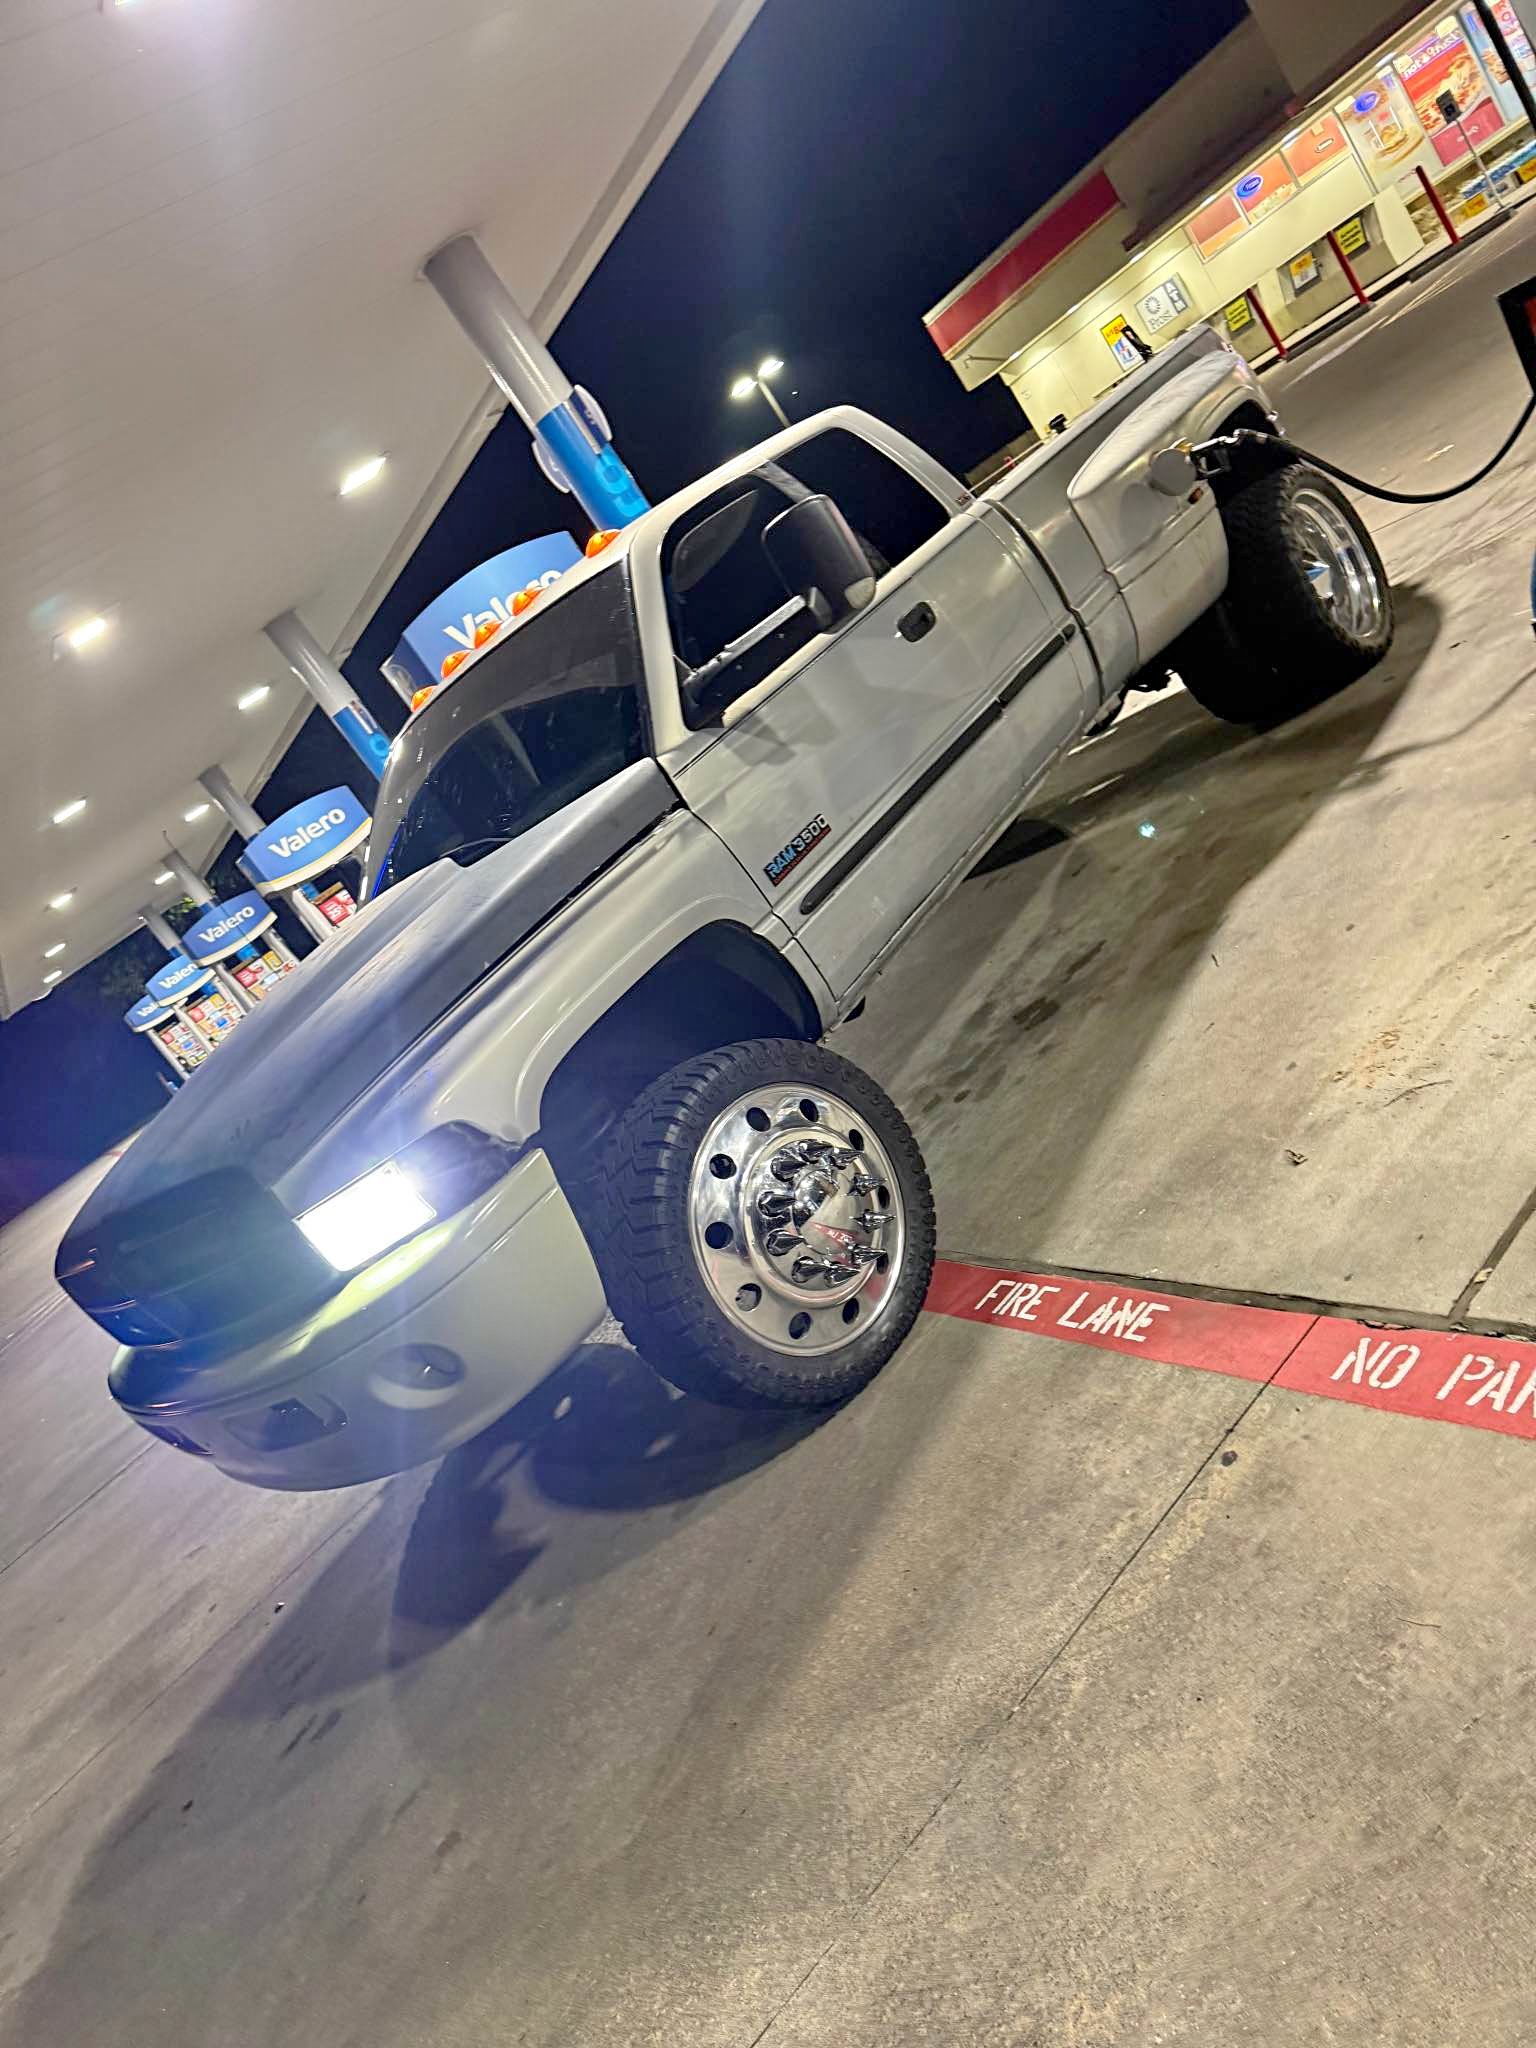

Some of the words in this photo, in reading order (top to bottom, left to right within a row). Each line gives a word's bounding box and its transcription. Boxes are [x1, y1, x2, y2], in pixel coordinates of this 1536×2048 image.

[267, 808, 346, 858] Valero
[766, 845, 798, 878] RAM
[792, 814, 829, 851] 3500
[198, 905, 256, 943] Valero
[158, 963, 198, 989] Valer
[974, 1279, 1061, 1321] FIRE
[1056, 1291, 1170, 1342] LANE
[1329, 1337, 1421, 1389] NO
